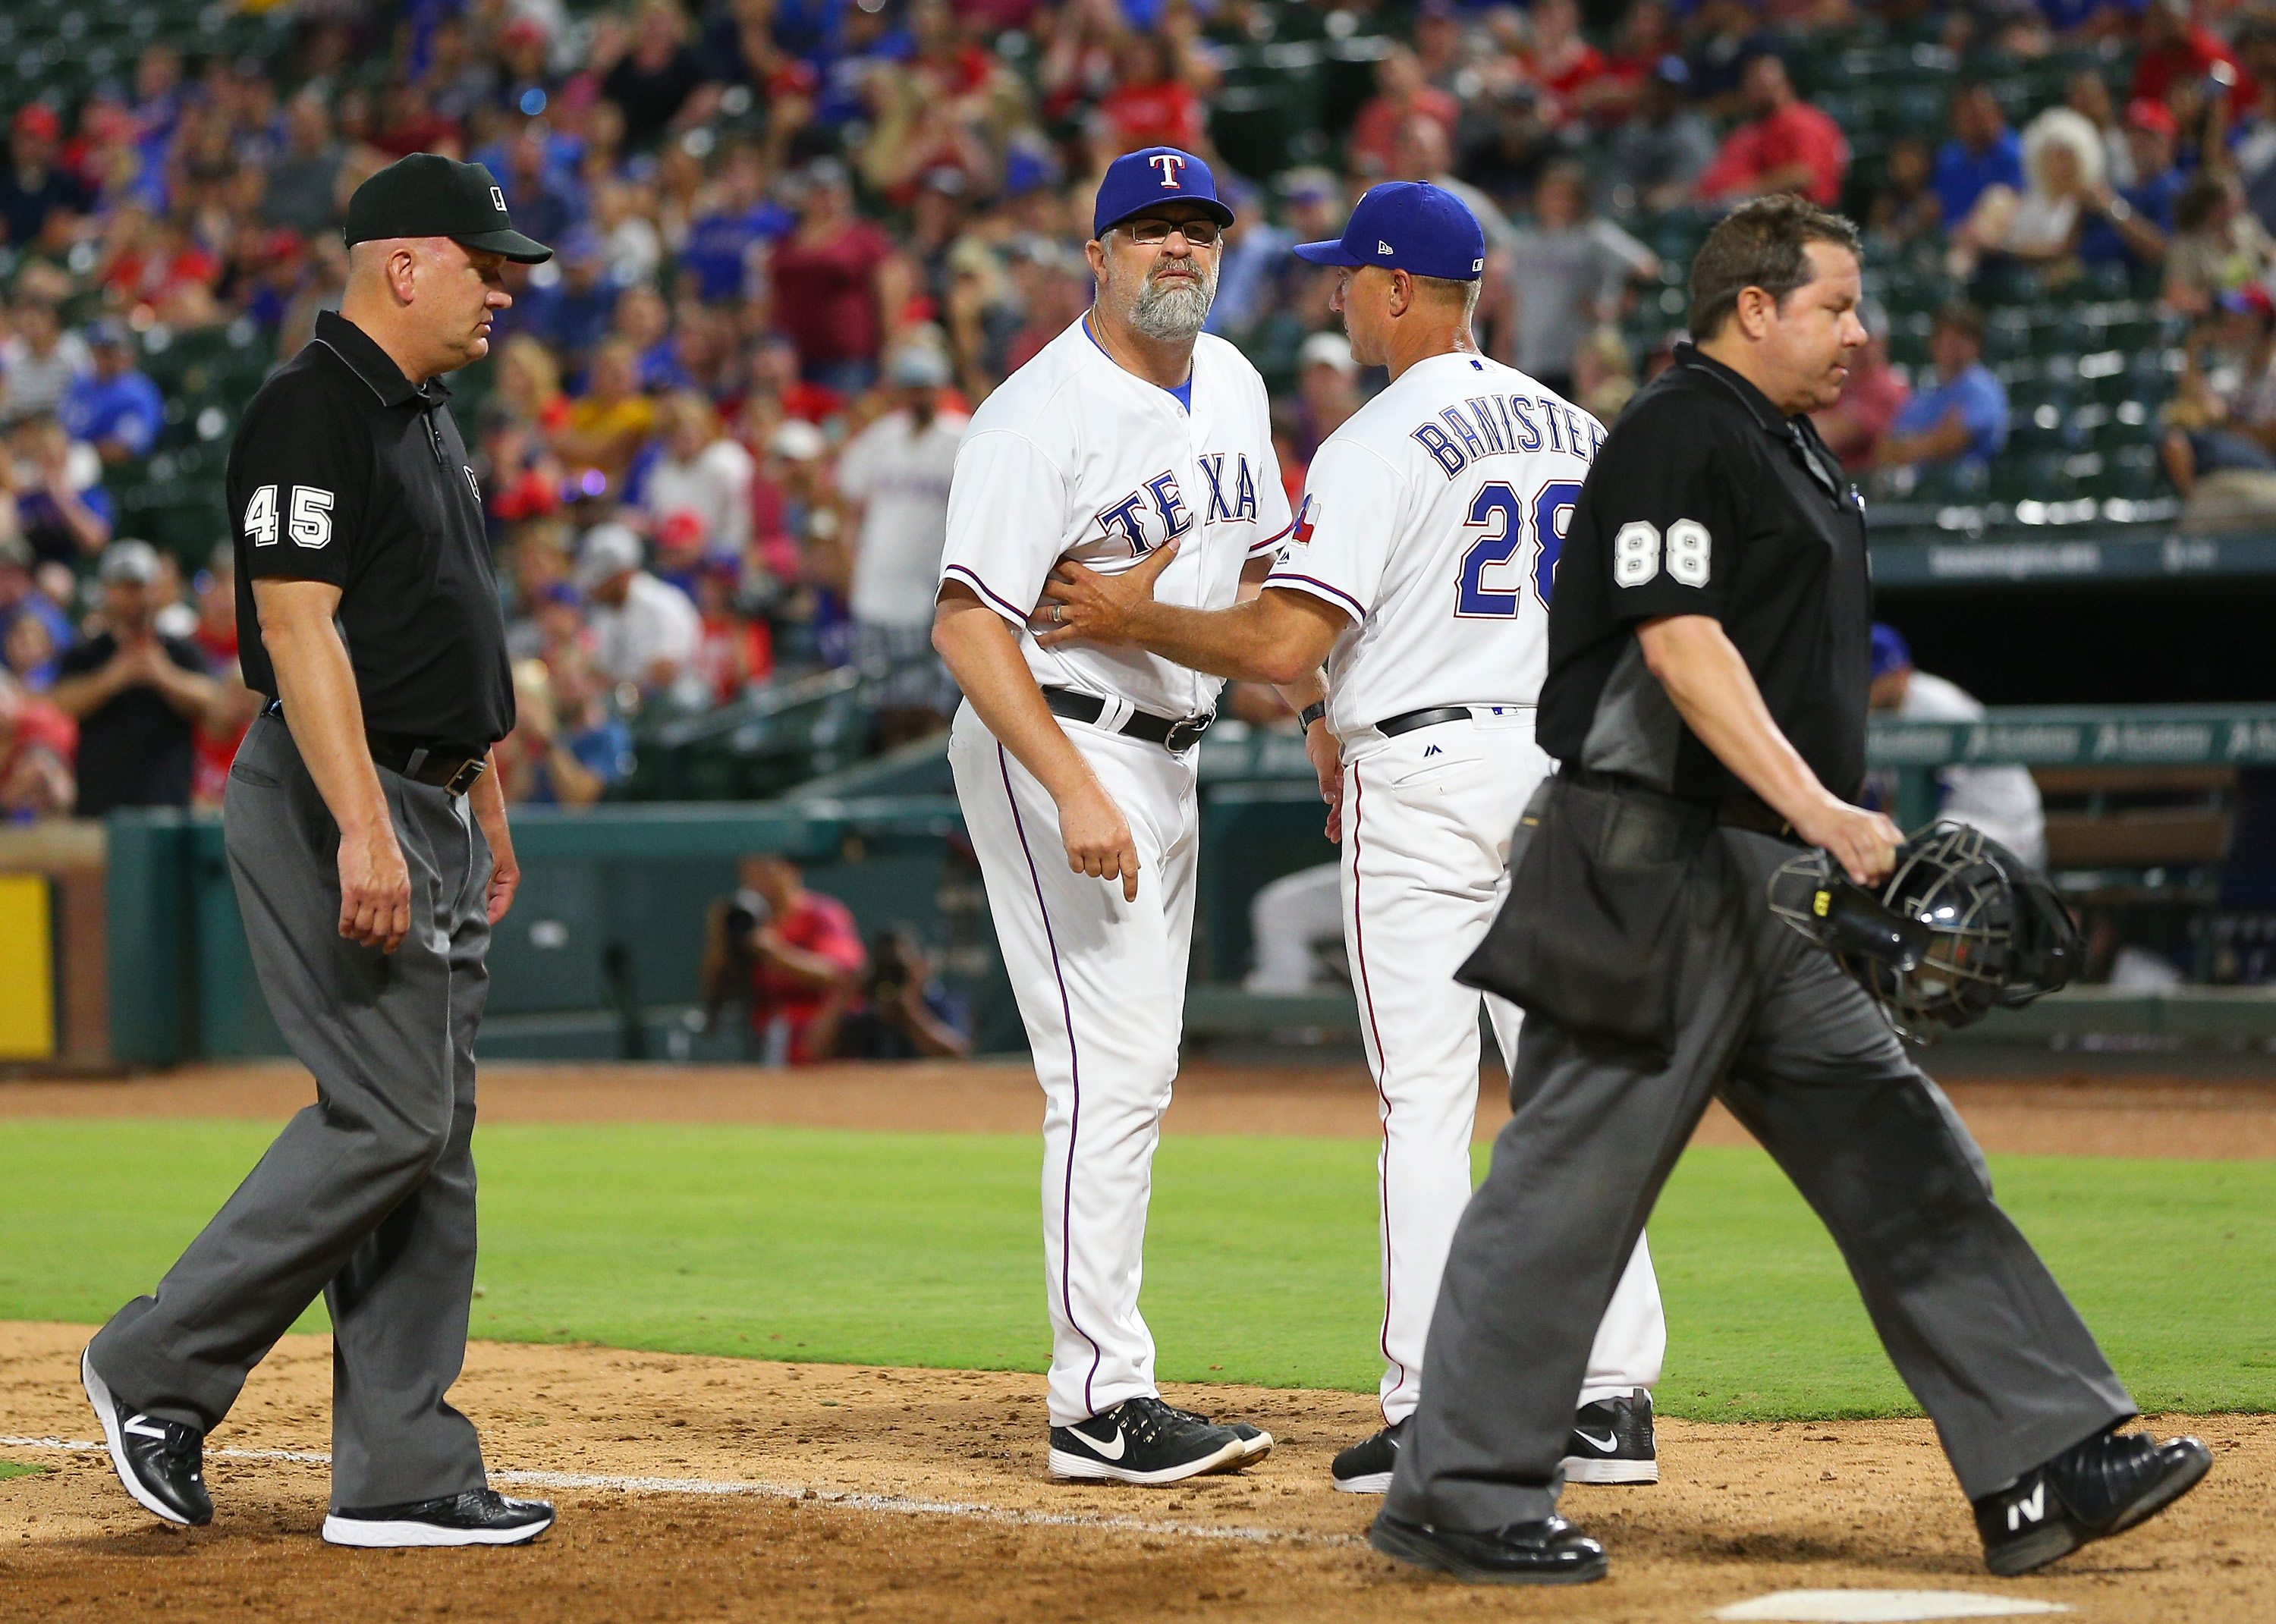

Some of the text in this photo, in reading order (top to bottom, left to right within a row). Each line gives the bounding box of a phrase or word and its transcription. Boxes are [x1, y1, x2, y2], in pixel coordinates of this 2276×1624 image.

[1149, 155, 1186, 190] T
[244, 485, 334, 550] 45
[1095, 453, 1263, 558] TEXA
[1614, 517, 1712, 589] 88
